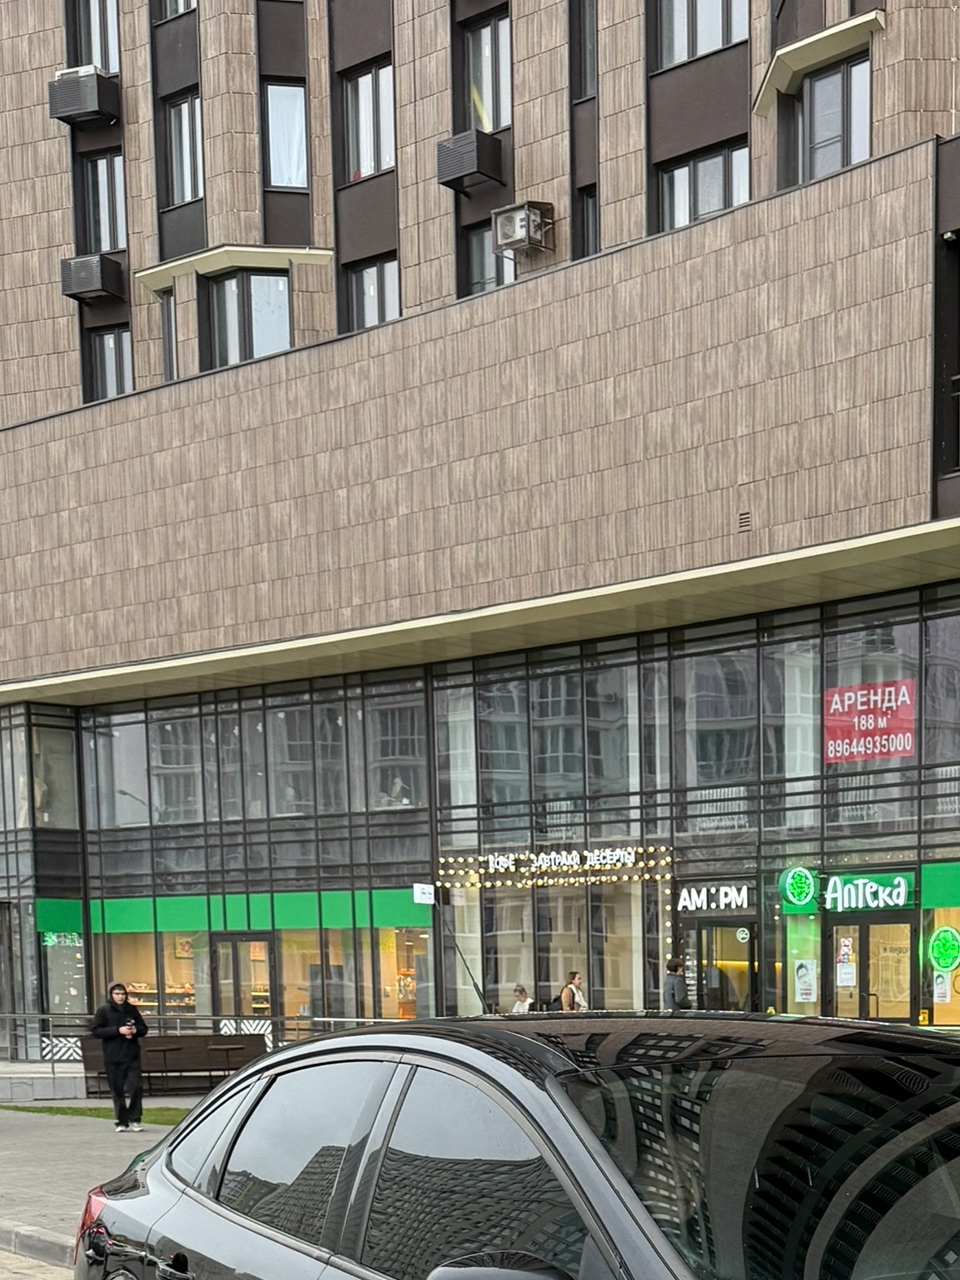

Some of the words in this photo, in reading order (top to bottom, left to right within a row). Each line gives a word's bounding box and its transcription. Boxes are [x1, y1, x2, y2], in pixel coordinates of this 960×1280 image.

[829, 685, 911, 714] АРЕНДА
[852, 714, 875, 731] 188
[828, 732, 912, 758] 89644935000
[488, 856, 516, 869] КОФЕ
[531, 853, 581, 868] ЗАВТРАКИ
[586, 850, 636, 866] ДЕСЕРТЫ
[824, 876, 906, 912] Аптека
